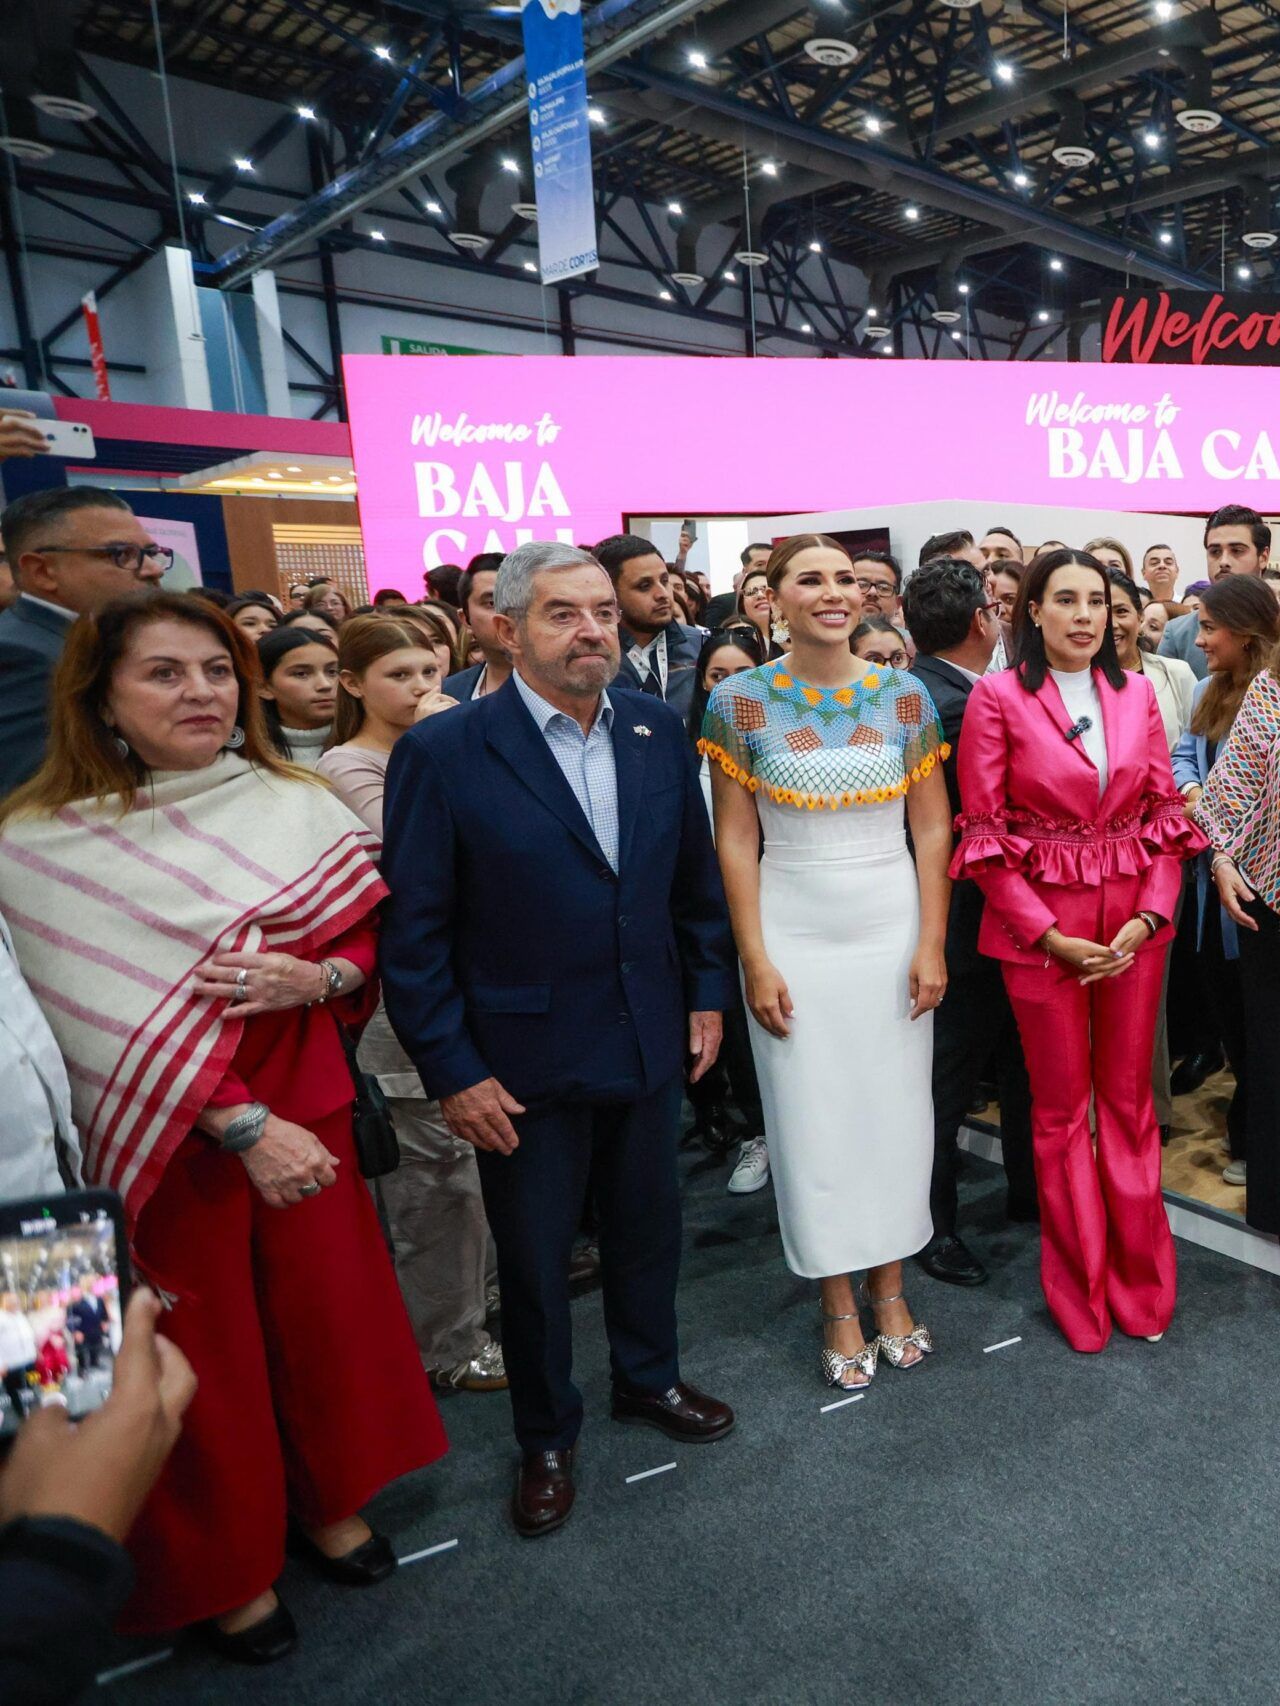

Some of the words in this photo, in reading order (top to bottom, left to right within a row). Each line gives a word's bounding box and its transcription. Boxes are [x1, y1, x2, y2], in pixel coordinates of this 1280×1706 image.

[410, 412, 533, 447] Welcome
[534, 412, 562, 447] to
[1026, 390, 1151, 428] Welcome
[1153, 393, 1182, 429] to
[1048, 427, 1185, 484] BAJA
[413, 461, 572, 523] BAJA
